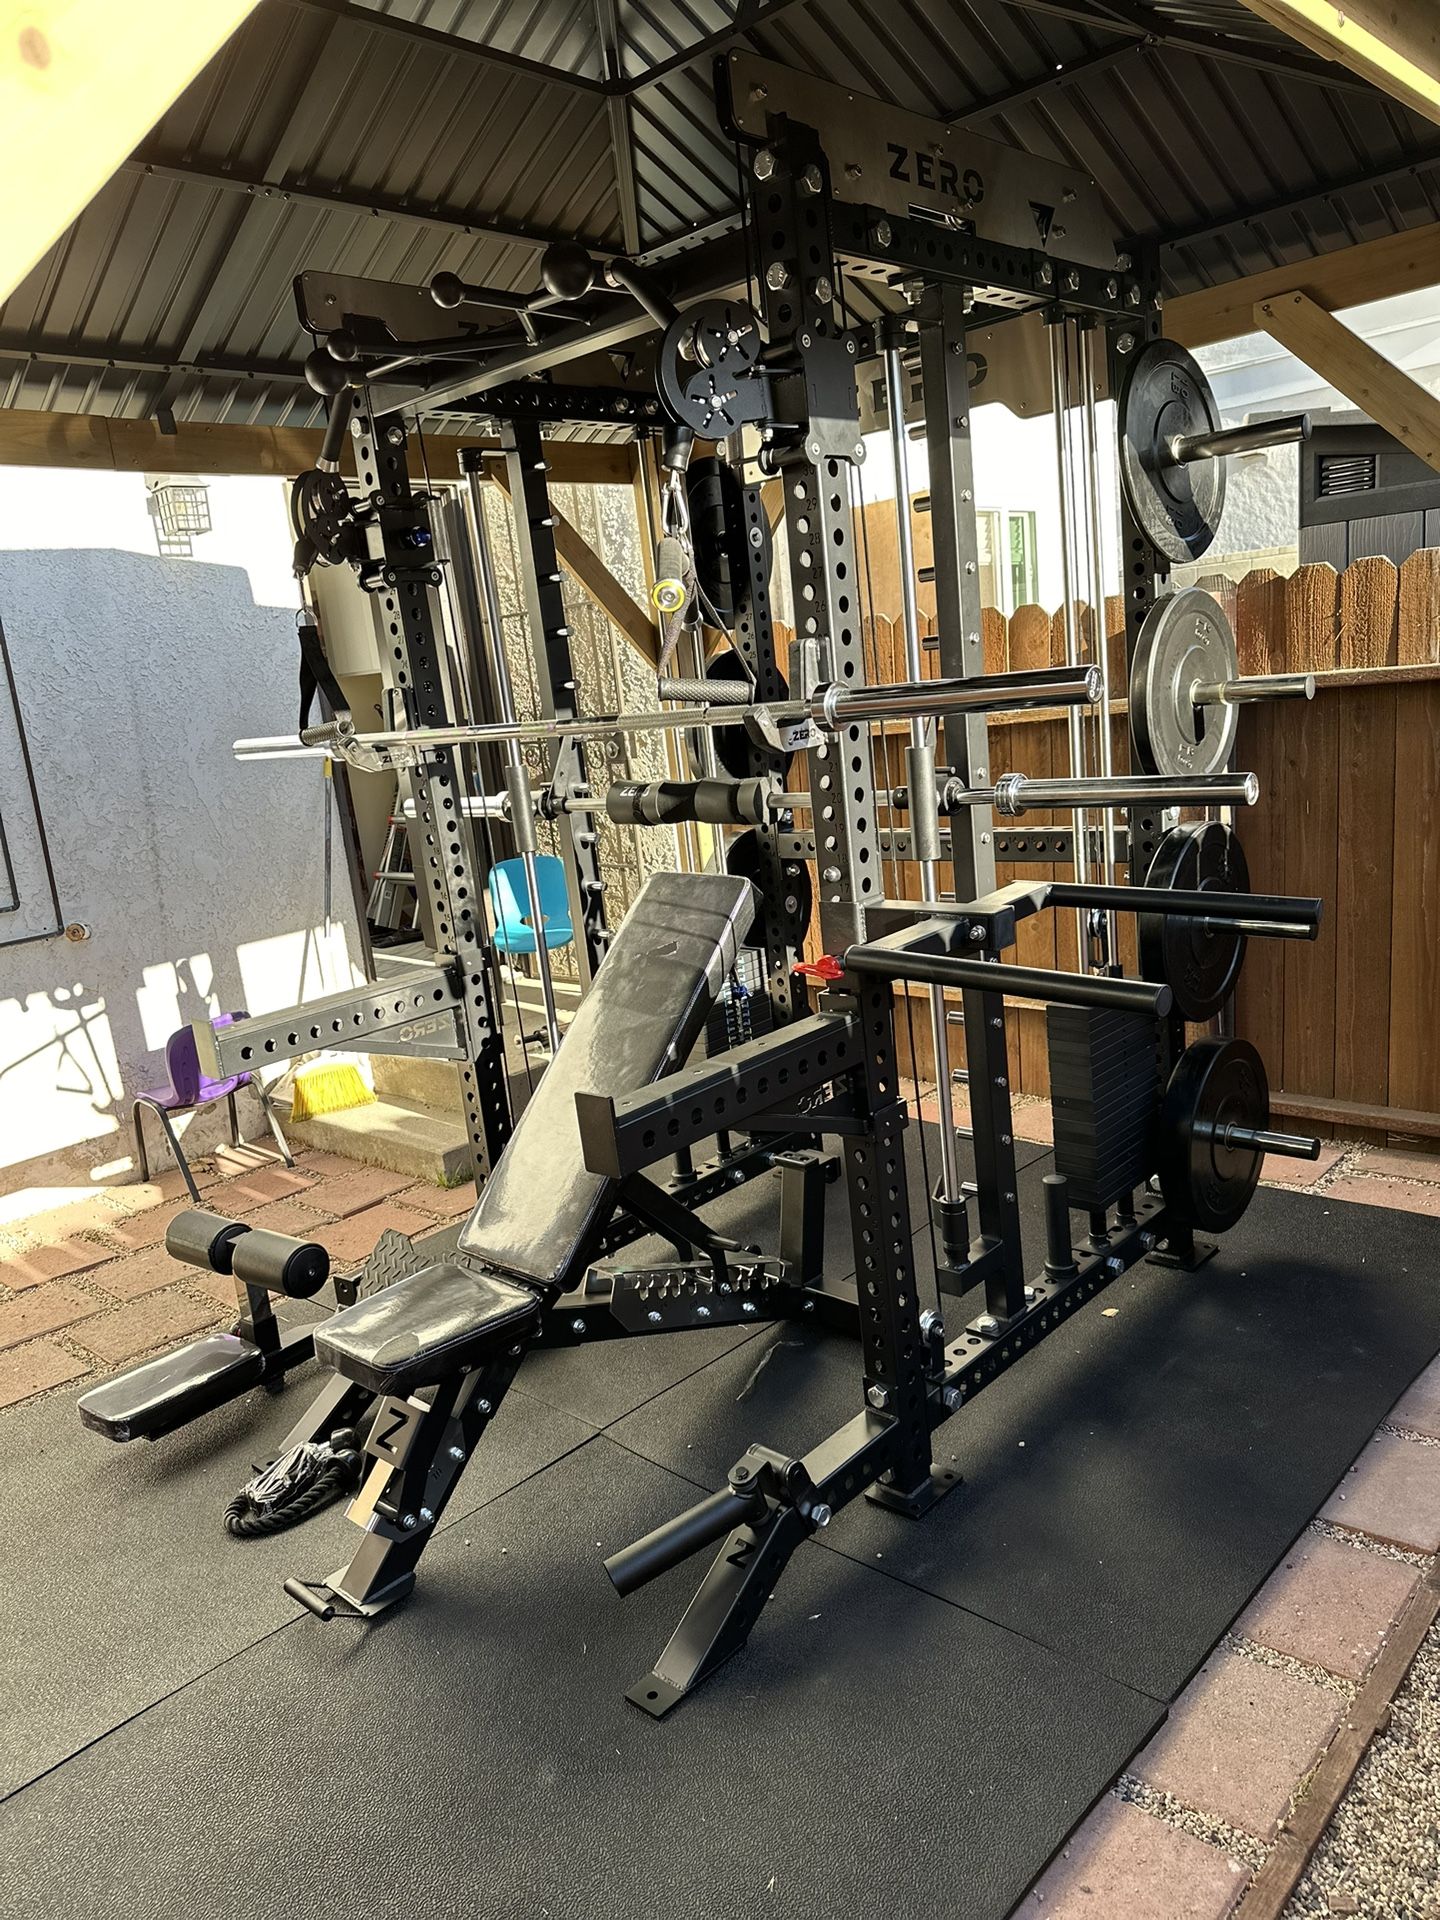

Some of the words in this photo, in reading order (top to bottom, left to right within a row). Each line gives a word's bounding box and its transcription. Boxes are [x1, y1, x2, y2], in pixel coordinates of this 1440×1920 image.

[887, 142, 984, 204] ZERO
[806, 497, 818, 511] 29
[809, 532, 821, 546] 28
[812, 566, 824, 580] 27
[815, 600, 827, 614] 26
[745, 613, 753, 621] 27
[792, 728, 816, 741] ZERO
[829, 762, 839, 773] 21
[620, 786, 650, 797] ZEO
[831, 792, 843, 804] 20
[834, 823, 845, 834] 19
[840, 883, 850, 894] 17
[375, 1406, 410, 1456] Z
[725, 1537, 757, 1570] Z
